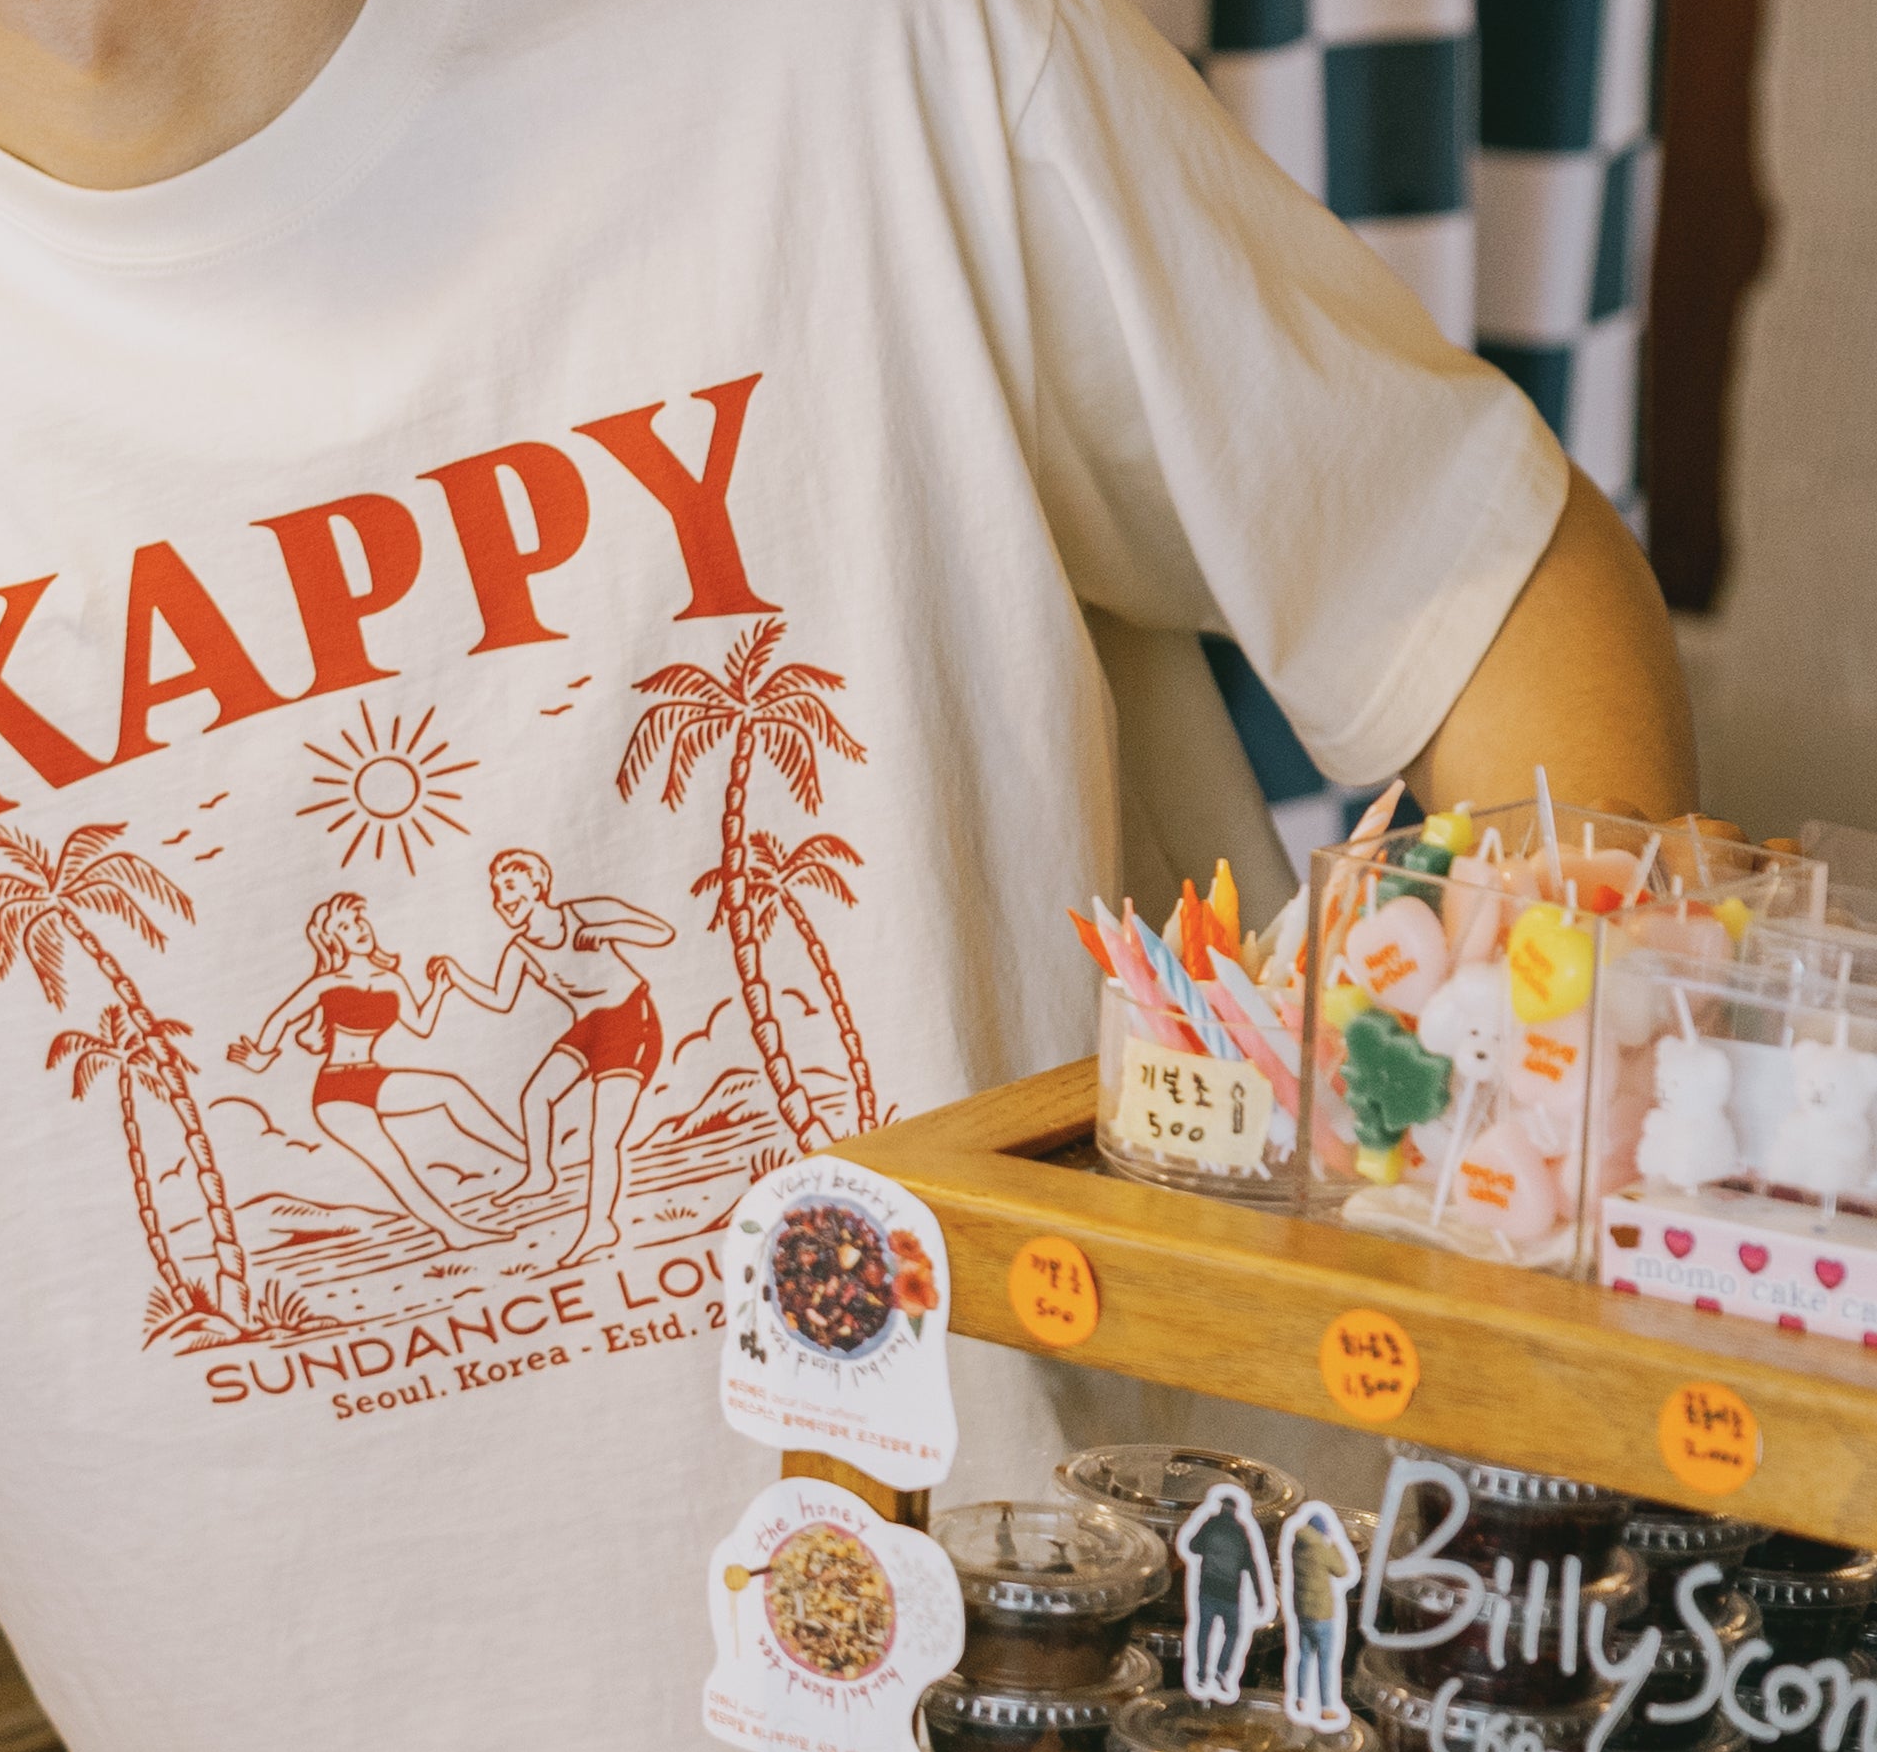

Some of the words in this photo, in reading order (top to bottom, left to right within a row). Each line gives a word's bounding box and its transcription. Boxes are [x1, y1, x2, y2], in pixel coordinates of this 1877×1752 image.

[1147, 1110, 1204, 1142] 500
[831, 1165, 899, 1223] berry
[1035, 1297, 1074, 1325] 500
[1635, 1255, 1736, 1295] momo
[1751, 1280, 1828, 1313] cake
[205, 1279, 594, 1404] SUNDANCE
[453, 1344, 571, 1394] Korea
[601, 1313, 699, 1355] Estd.
[755, 1516, 790, 1552] the
[797, 1493, 869, 1535] honey
[786, 1670, 836, 1711] blend
